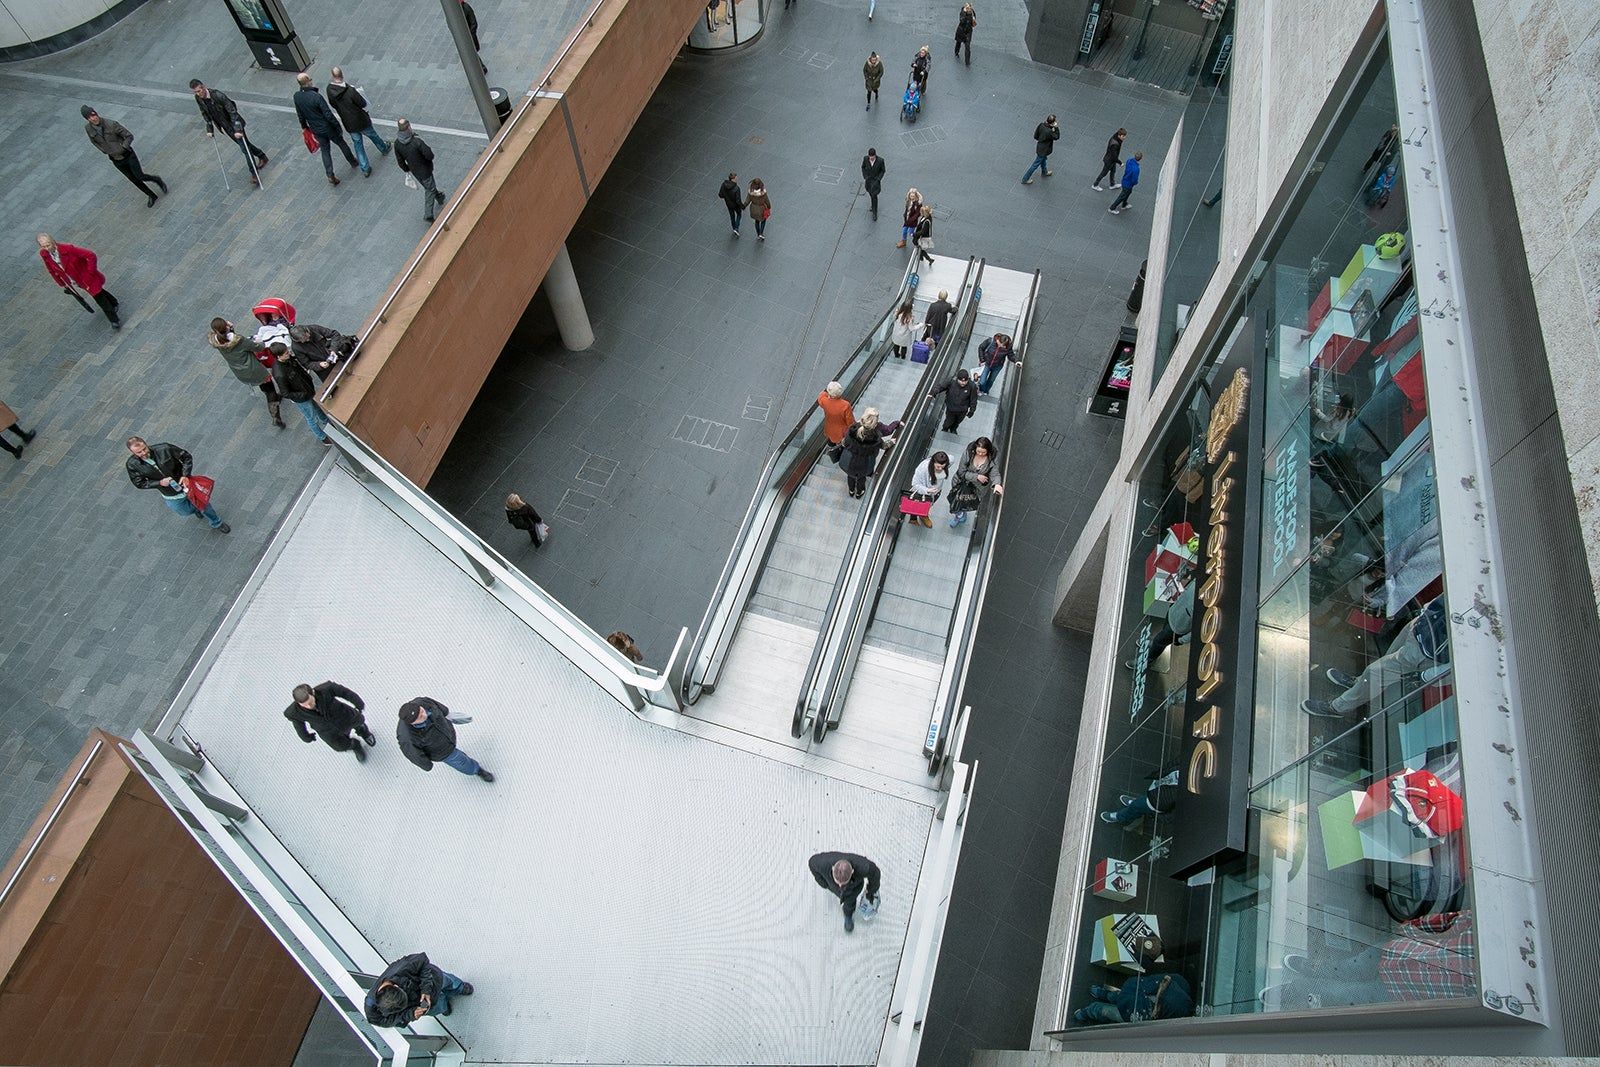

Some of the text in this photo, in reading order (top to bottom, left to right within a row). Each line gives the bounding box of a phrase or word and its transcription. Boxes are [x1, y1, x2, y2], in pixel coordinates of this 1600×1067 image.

[1272, 447, 1286, 577] LIVERPOOL
[1285, 438, 1298, 556] MADE FOR
[1142, 622, 1152, 672] MADE
[1187, 451, 1237, 794] Liverpool FC
